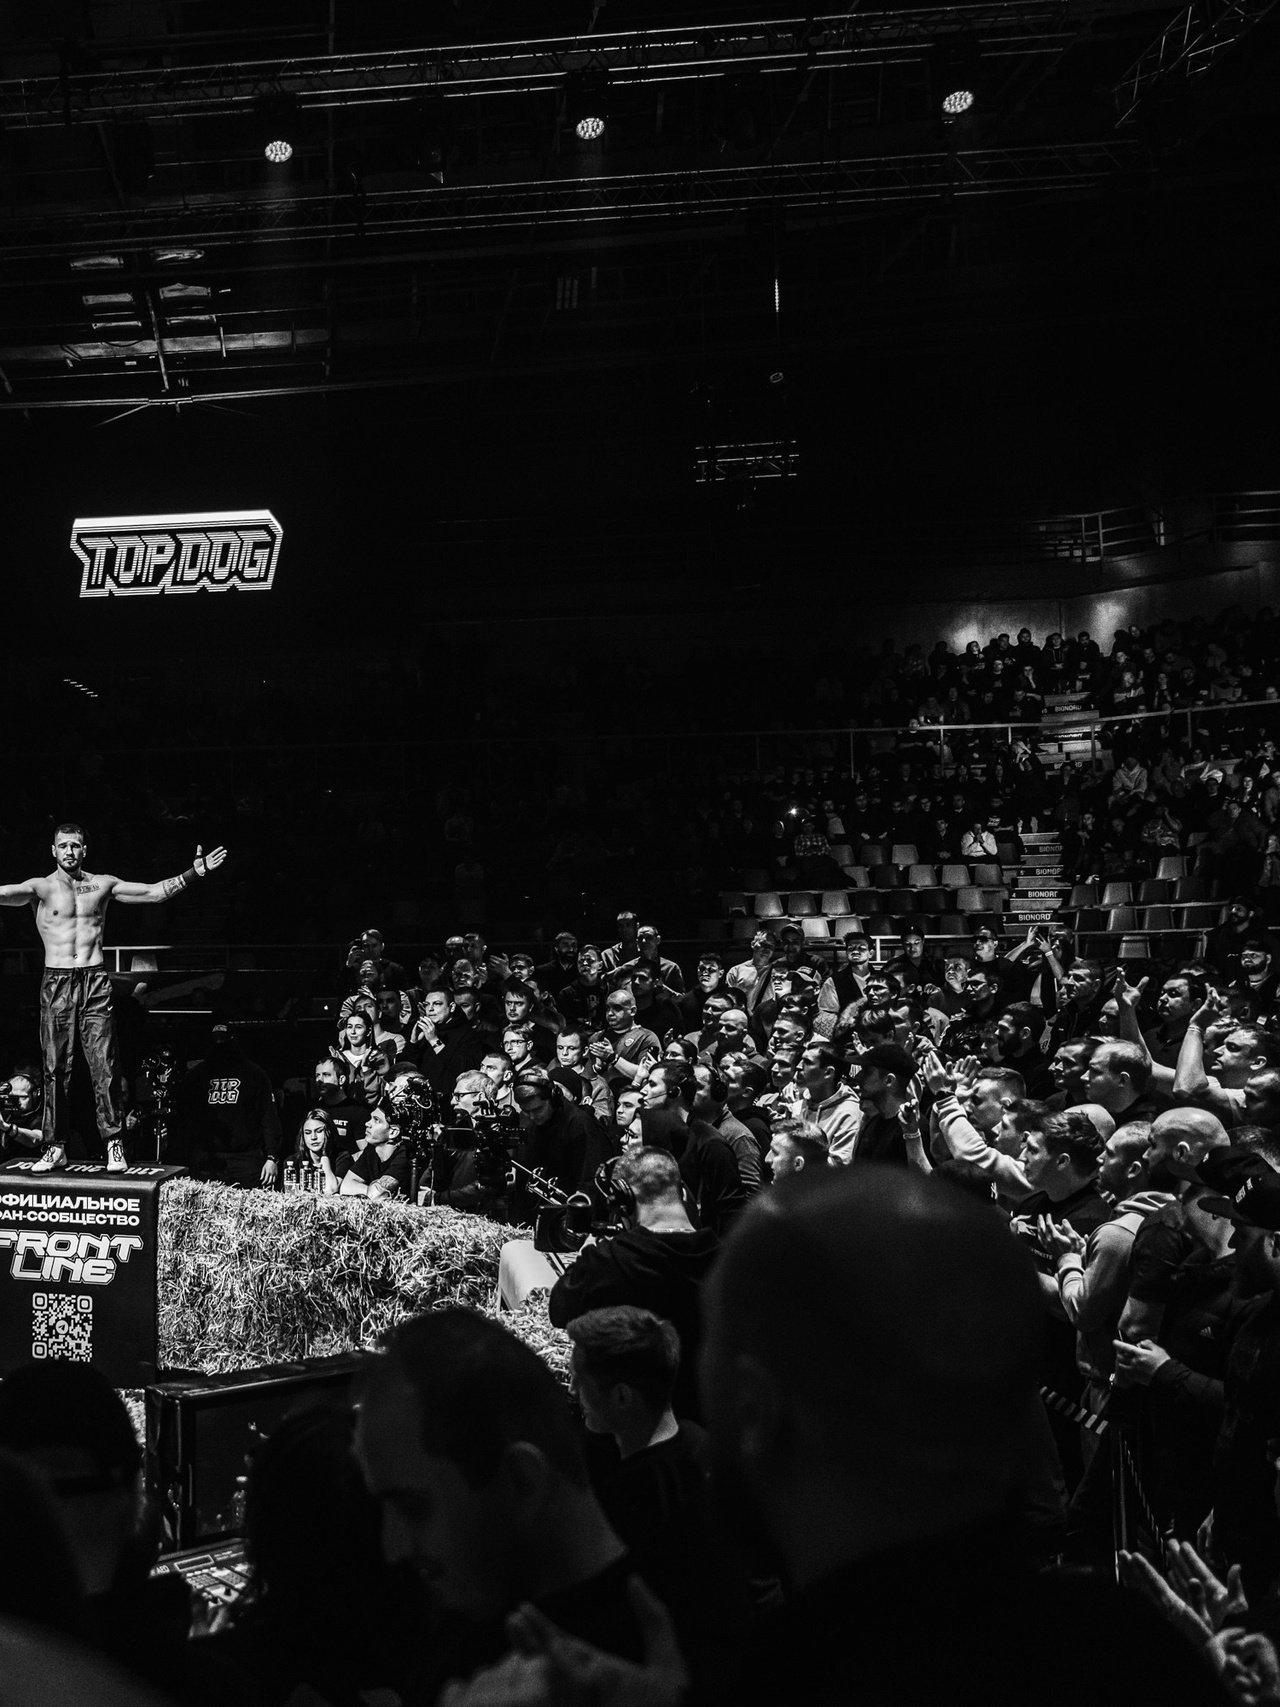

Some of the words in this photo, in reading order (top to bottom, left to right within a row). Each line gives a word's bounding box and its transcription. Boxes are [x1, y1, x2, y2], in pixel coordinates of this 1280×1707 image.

[1018, 913, 1051, 921] BIONORD
[64, 1164, 106, 1173] THE
[123, 1166, 165, 1176] ULT
[10, 1252, 117, 1285] LINE
